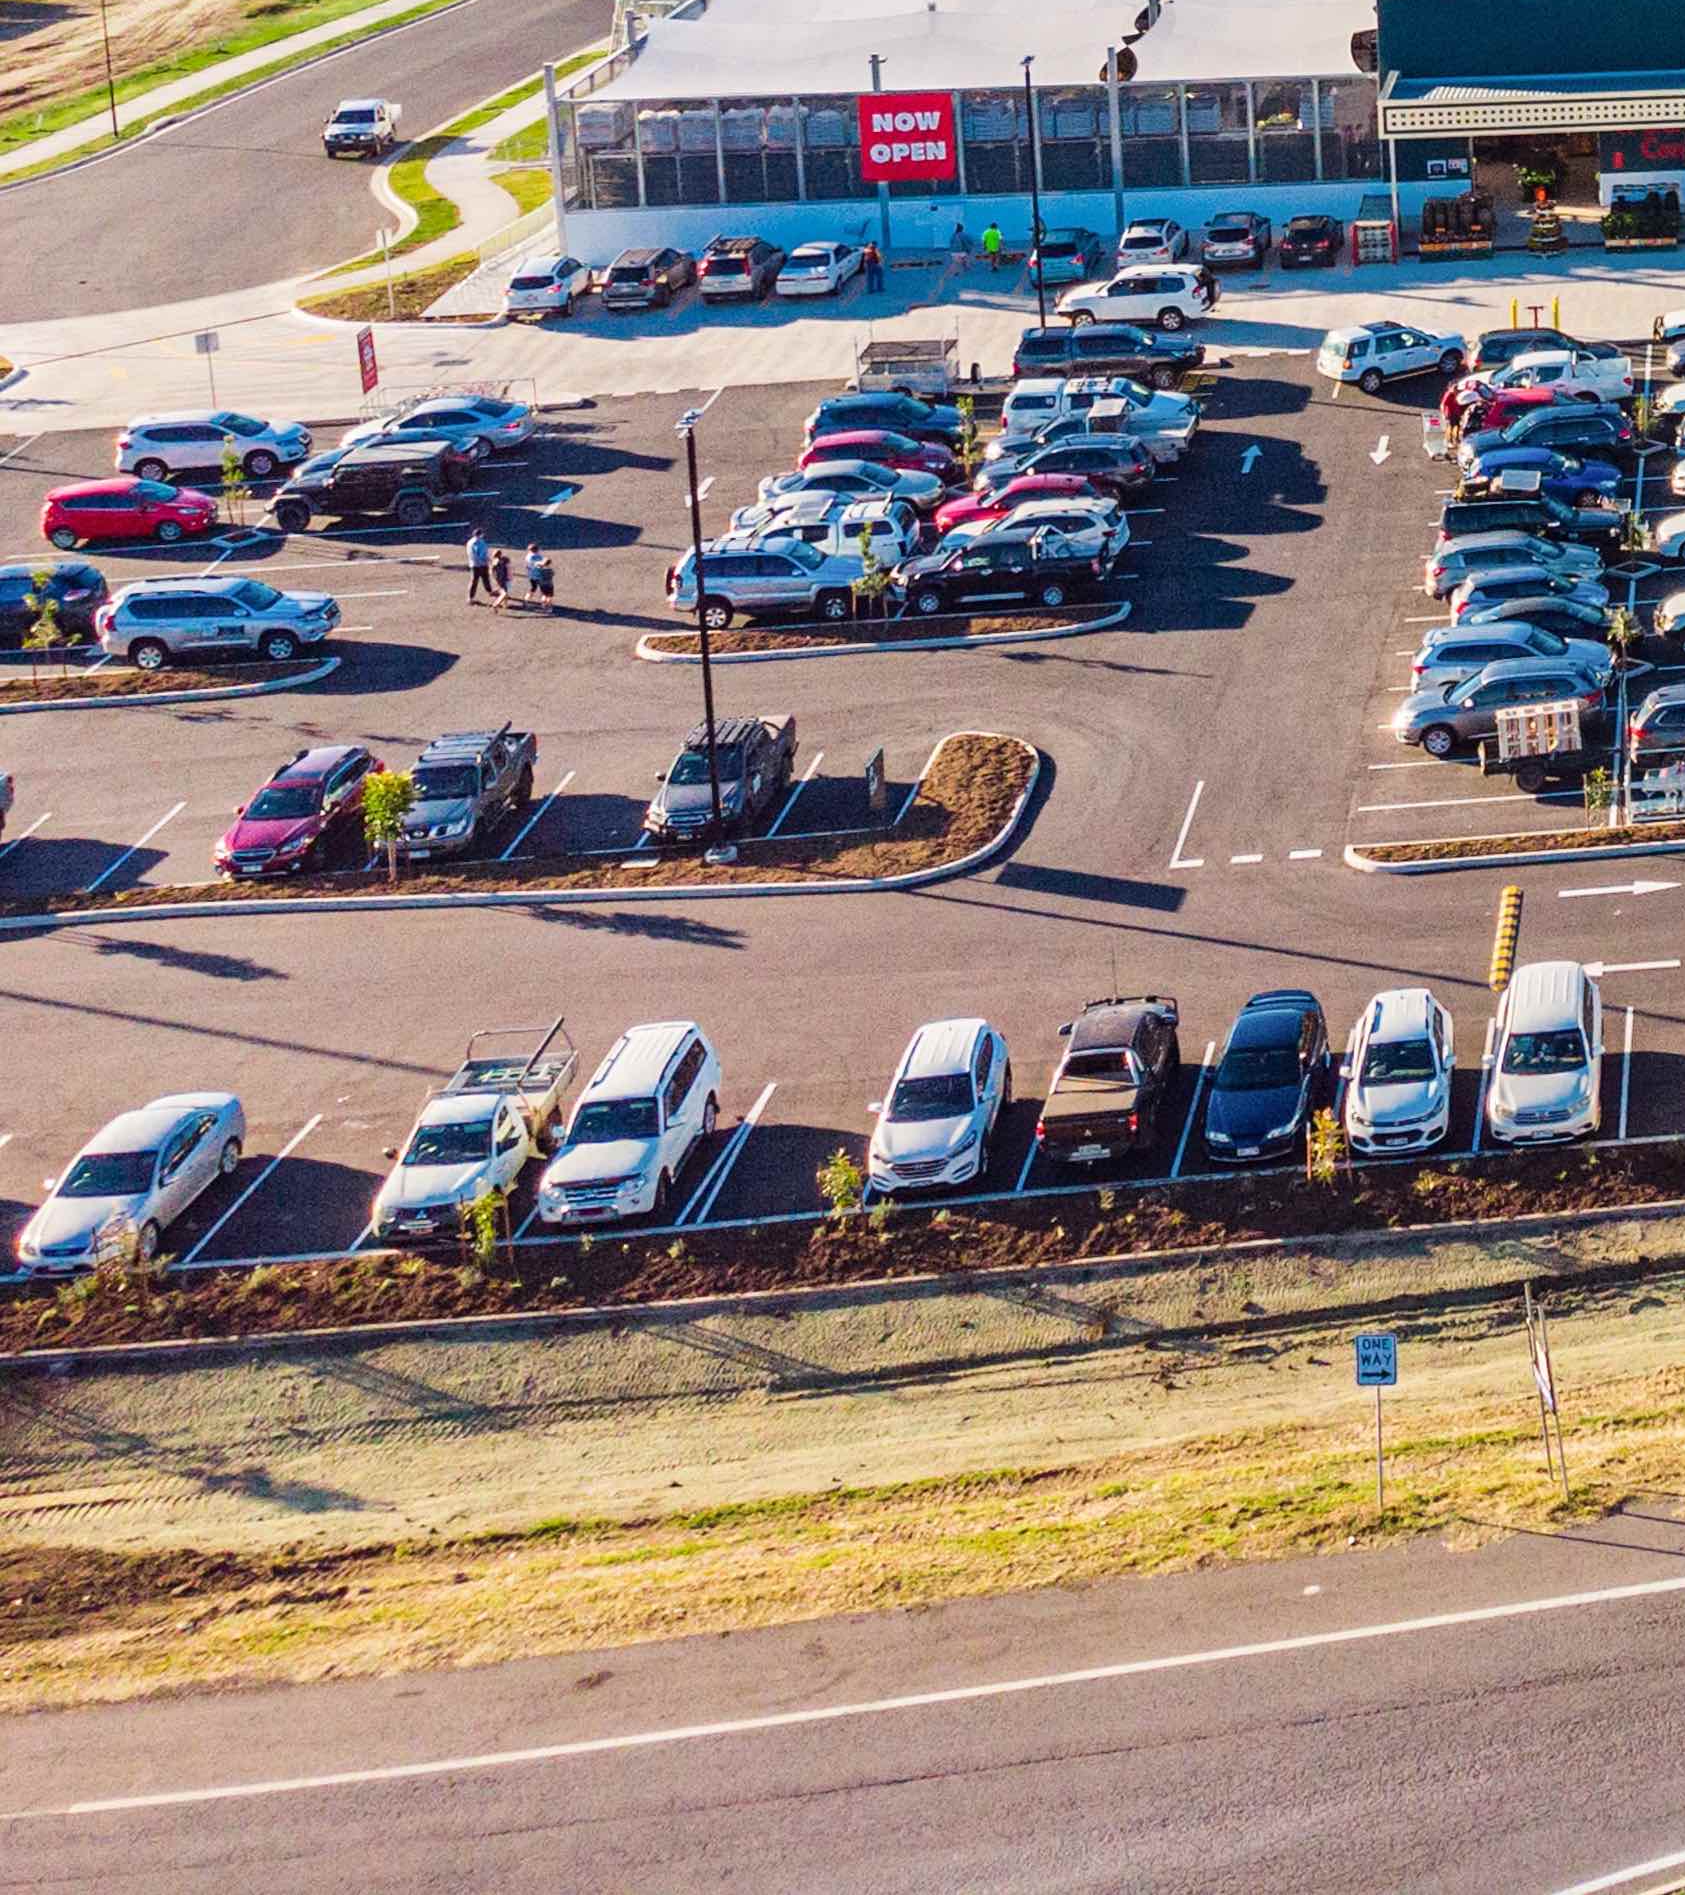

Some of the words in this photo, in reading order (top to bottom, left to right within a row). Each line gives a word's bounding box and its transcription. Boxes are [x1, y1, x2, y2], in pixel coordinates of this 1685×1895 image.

[871, 111, 941, 133] NOW
[869, 141, 947, 164] OPEN
[1361, 1338, 1390, 1350] ONE
[1361, 1352, 1393, 1366] WAY
